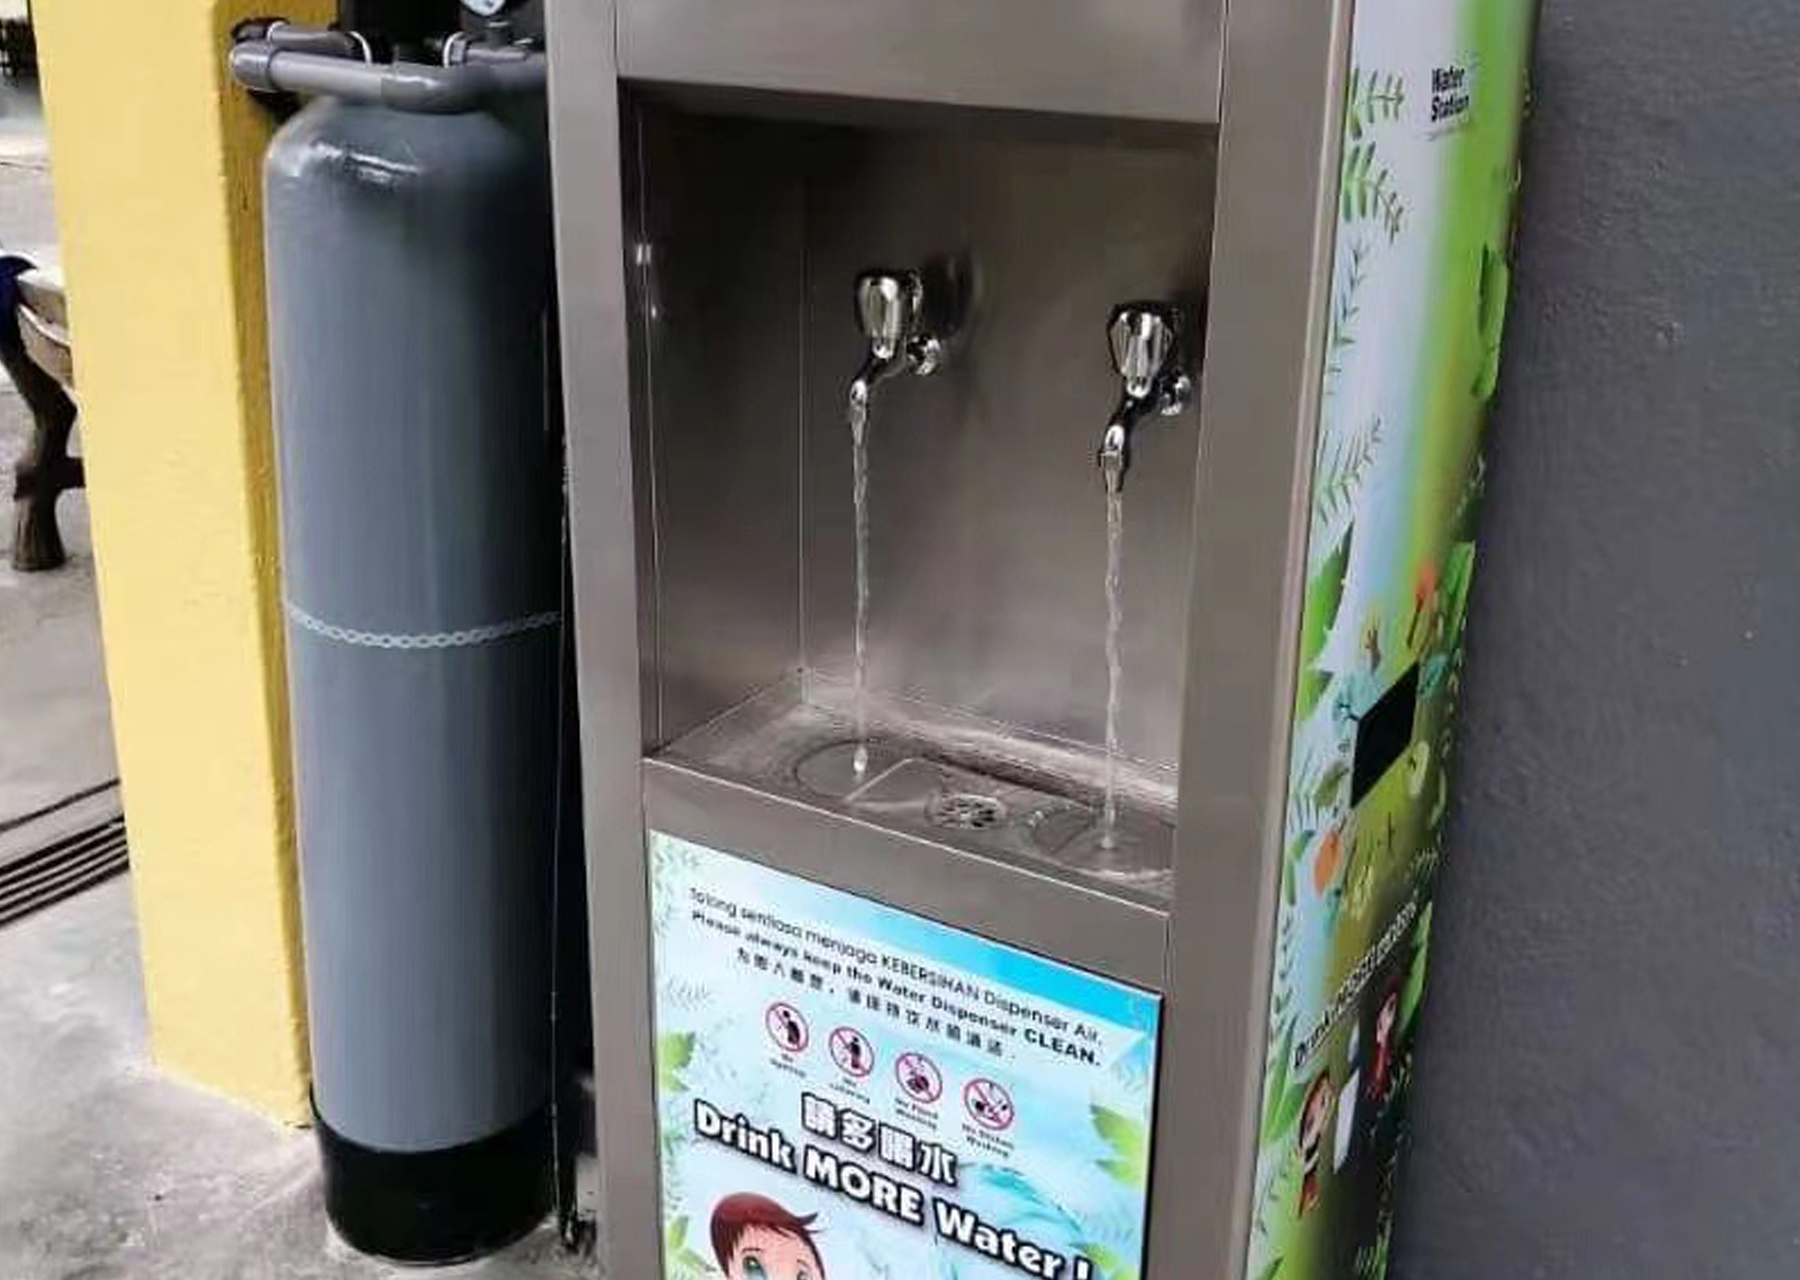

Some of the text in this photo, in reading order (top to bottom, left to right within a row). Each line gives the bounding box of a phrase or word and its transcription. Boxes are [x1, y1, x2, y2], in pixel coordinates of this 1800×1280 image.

[1431, 95, 1469, 122] Station
[745, 931, 798, 958] always
[803, 950, 842, 975] keep
[846, 965, 873, 984] the
[878, 976, 926, 1003] Water
[932, 995, 1018, 1036] Dispenser
[1024, 1027, 1100, 1066] CLEAN.
[805, 930, 877, 964] menjaga
[881, 953, 980, 1000] KEBERSIHAN
[984, 989, 1069, 1032] Dispenser
[694, 1099, 798, 1174] Drink
[803, 1144, 925, 1226] MORE
[931, 1196, 1067, 1280] Water
